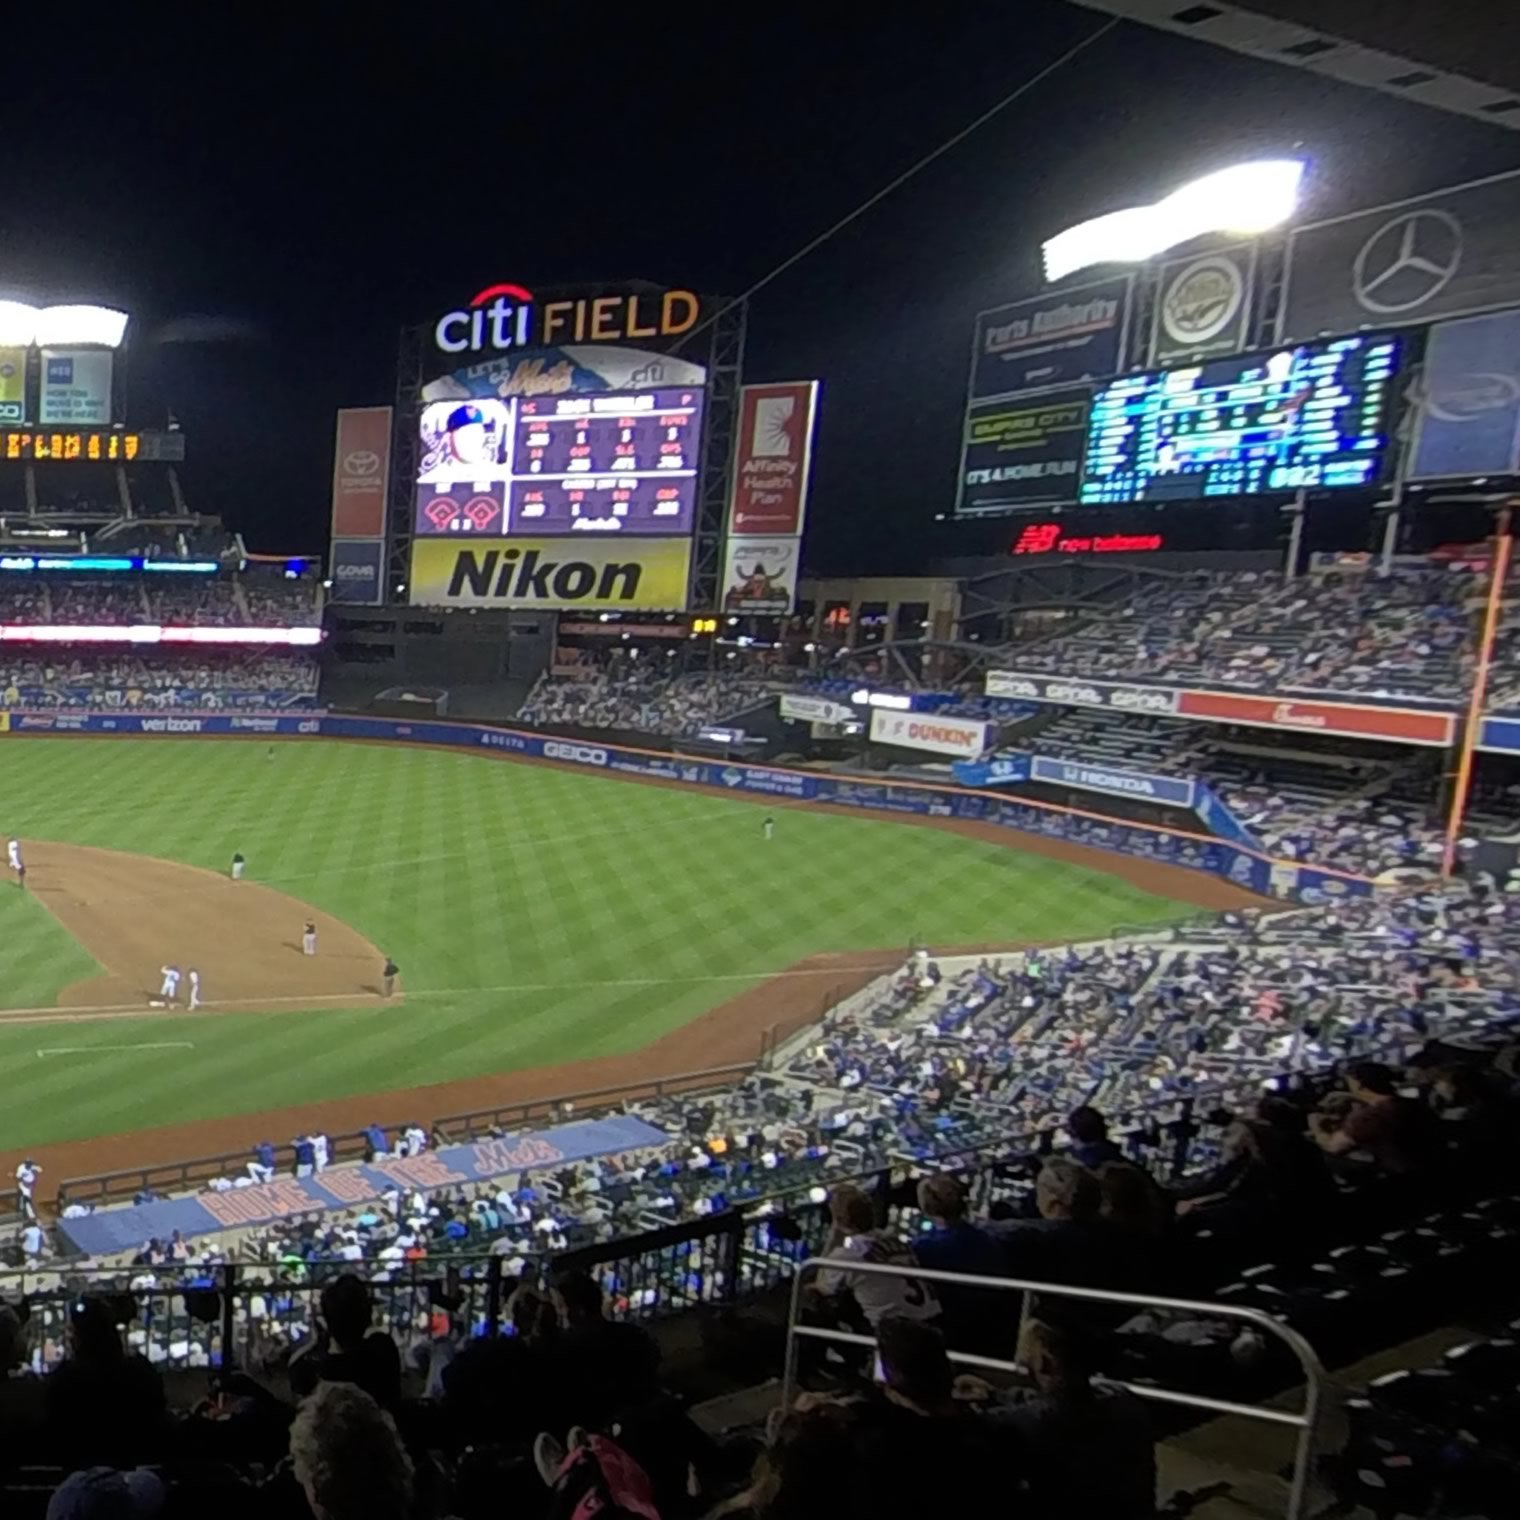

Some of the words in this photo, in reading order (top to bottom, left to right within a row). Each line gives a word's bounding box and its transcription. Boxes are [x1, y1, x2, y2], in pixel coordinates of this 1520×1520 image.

[543, 290, 699, 344] FIELD
[985, 320, 1029, 351] Parts
[1032, 299, 1118, 334] Authority
[1038, 411, 1078, 427] CITY
[741, 459, 799, 475] Affinity
[744, 477, 793, 489] Health
[751, 491, 784, 505] Plan
[447, 548, 642, 600] Nikon
[141, 719, 201, 732] verizon
[908, 723, 978, 748] DUNKIN'
[491, 737, 525, 749] DELTA
[543, 742, 607, 765] GEICO
[1081, 770, 1155, 794] HONDA
[196, 1180, 326, 1227] HOME
[313, 1168, 376, 1202] OF
[377, 1152, 468, 1188] THE
[473, 1137, 564, 1175] Mets
